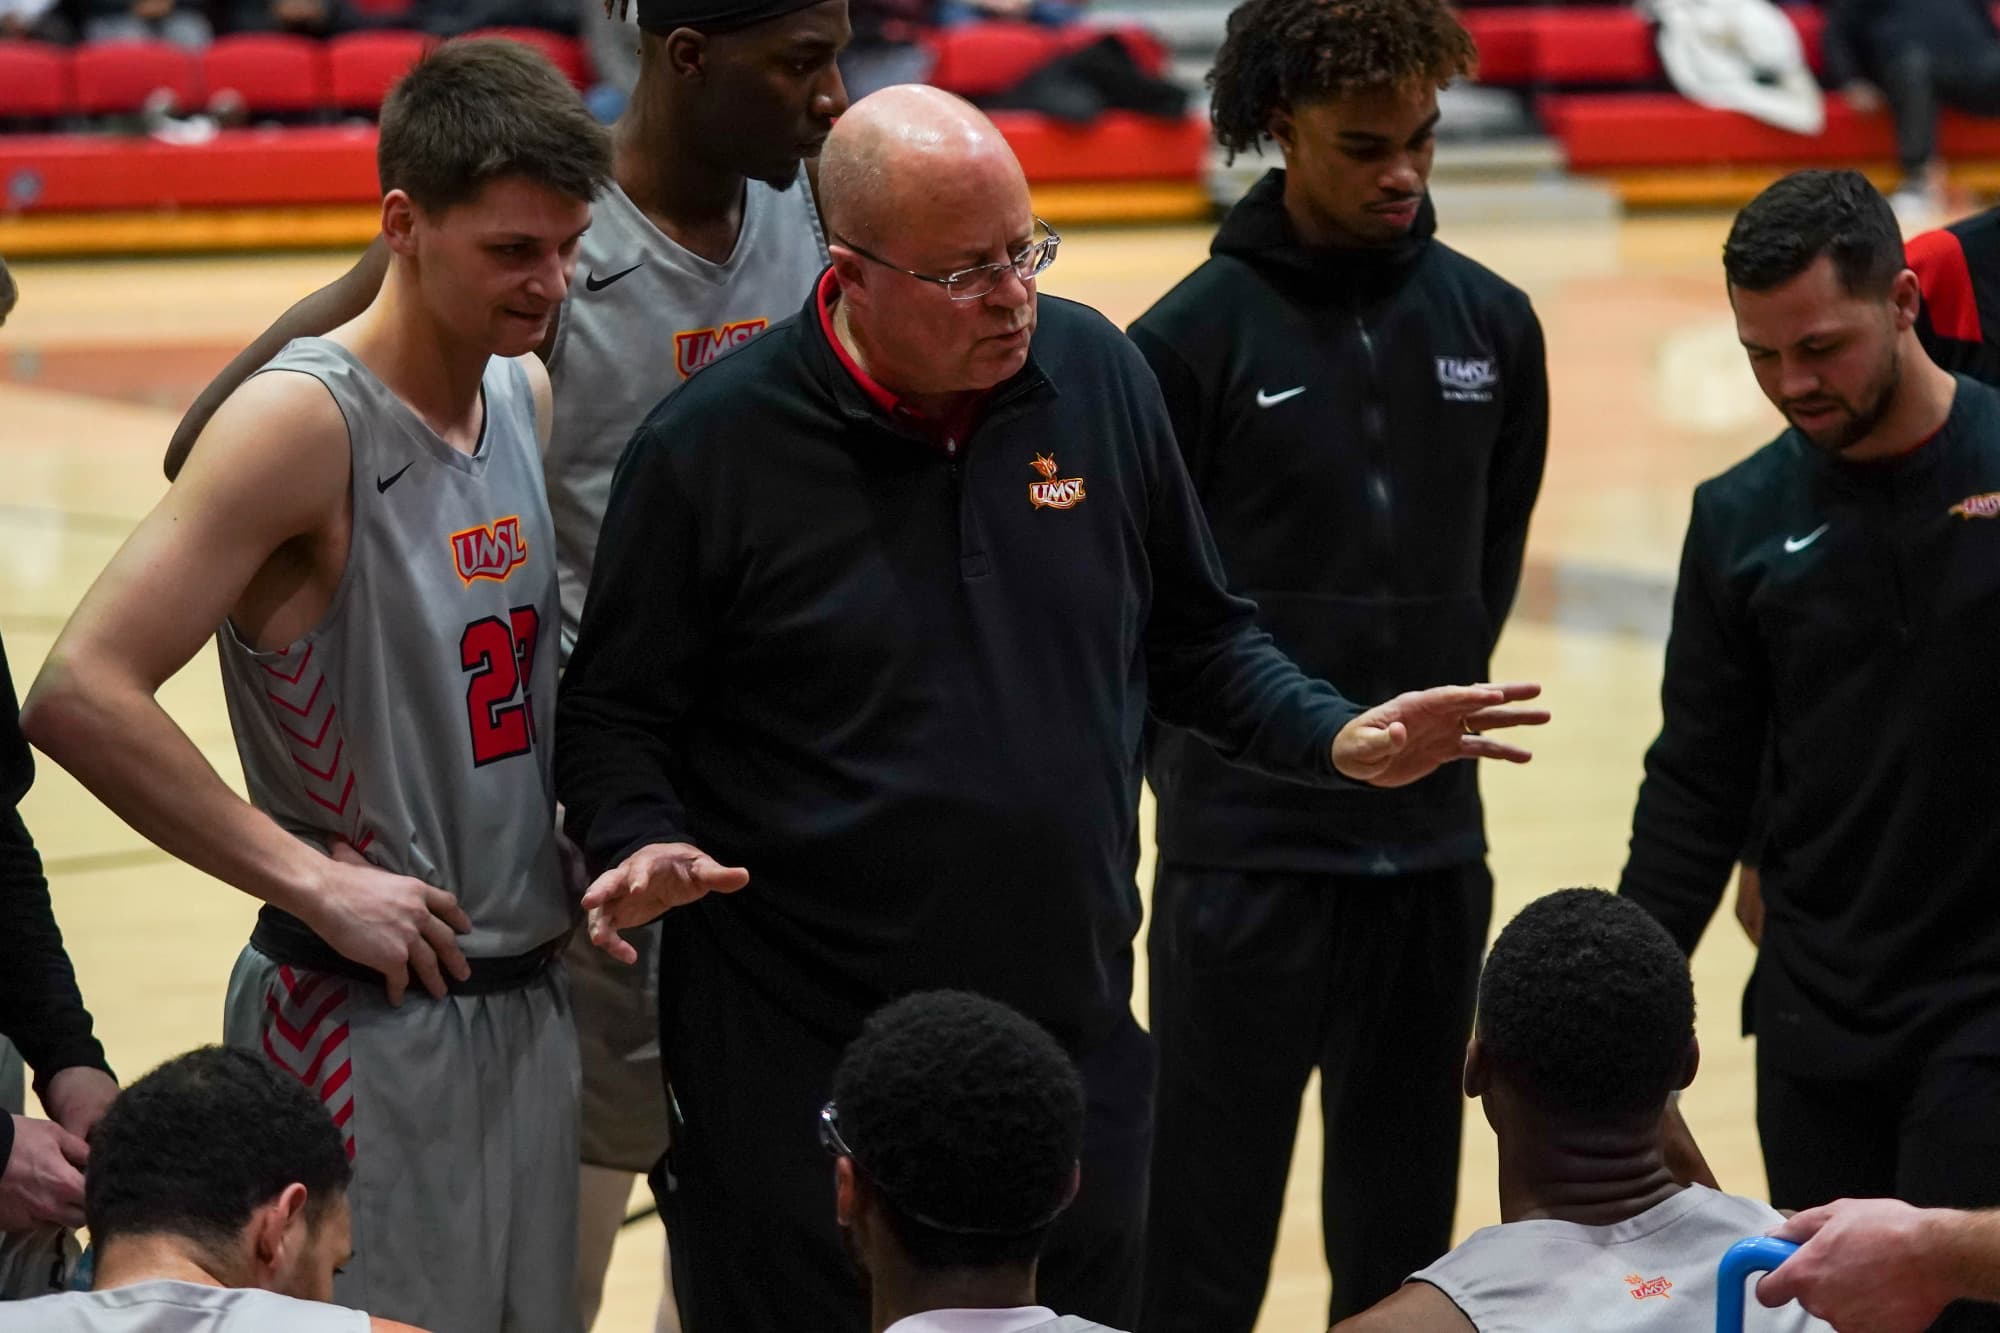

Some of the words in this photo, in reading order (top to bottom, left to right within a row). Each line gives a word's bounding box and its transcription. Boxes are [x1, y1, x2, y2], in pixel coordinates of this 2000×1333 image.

[1030, 480, 1087, 506] UMSL
[453, 519, 527, 580] UMSL
[1631, 1279, 1672, 1299] UMSL
